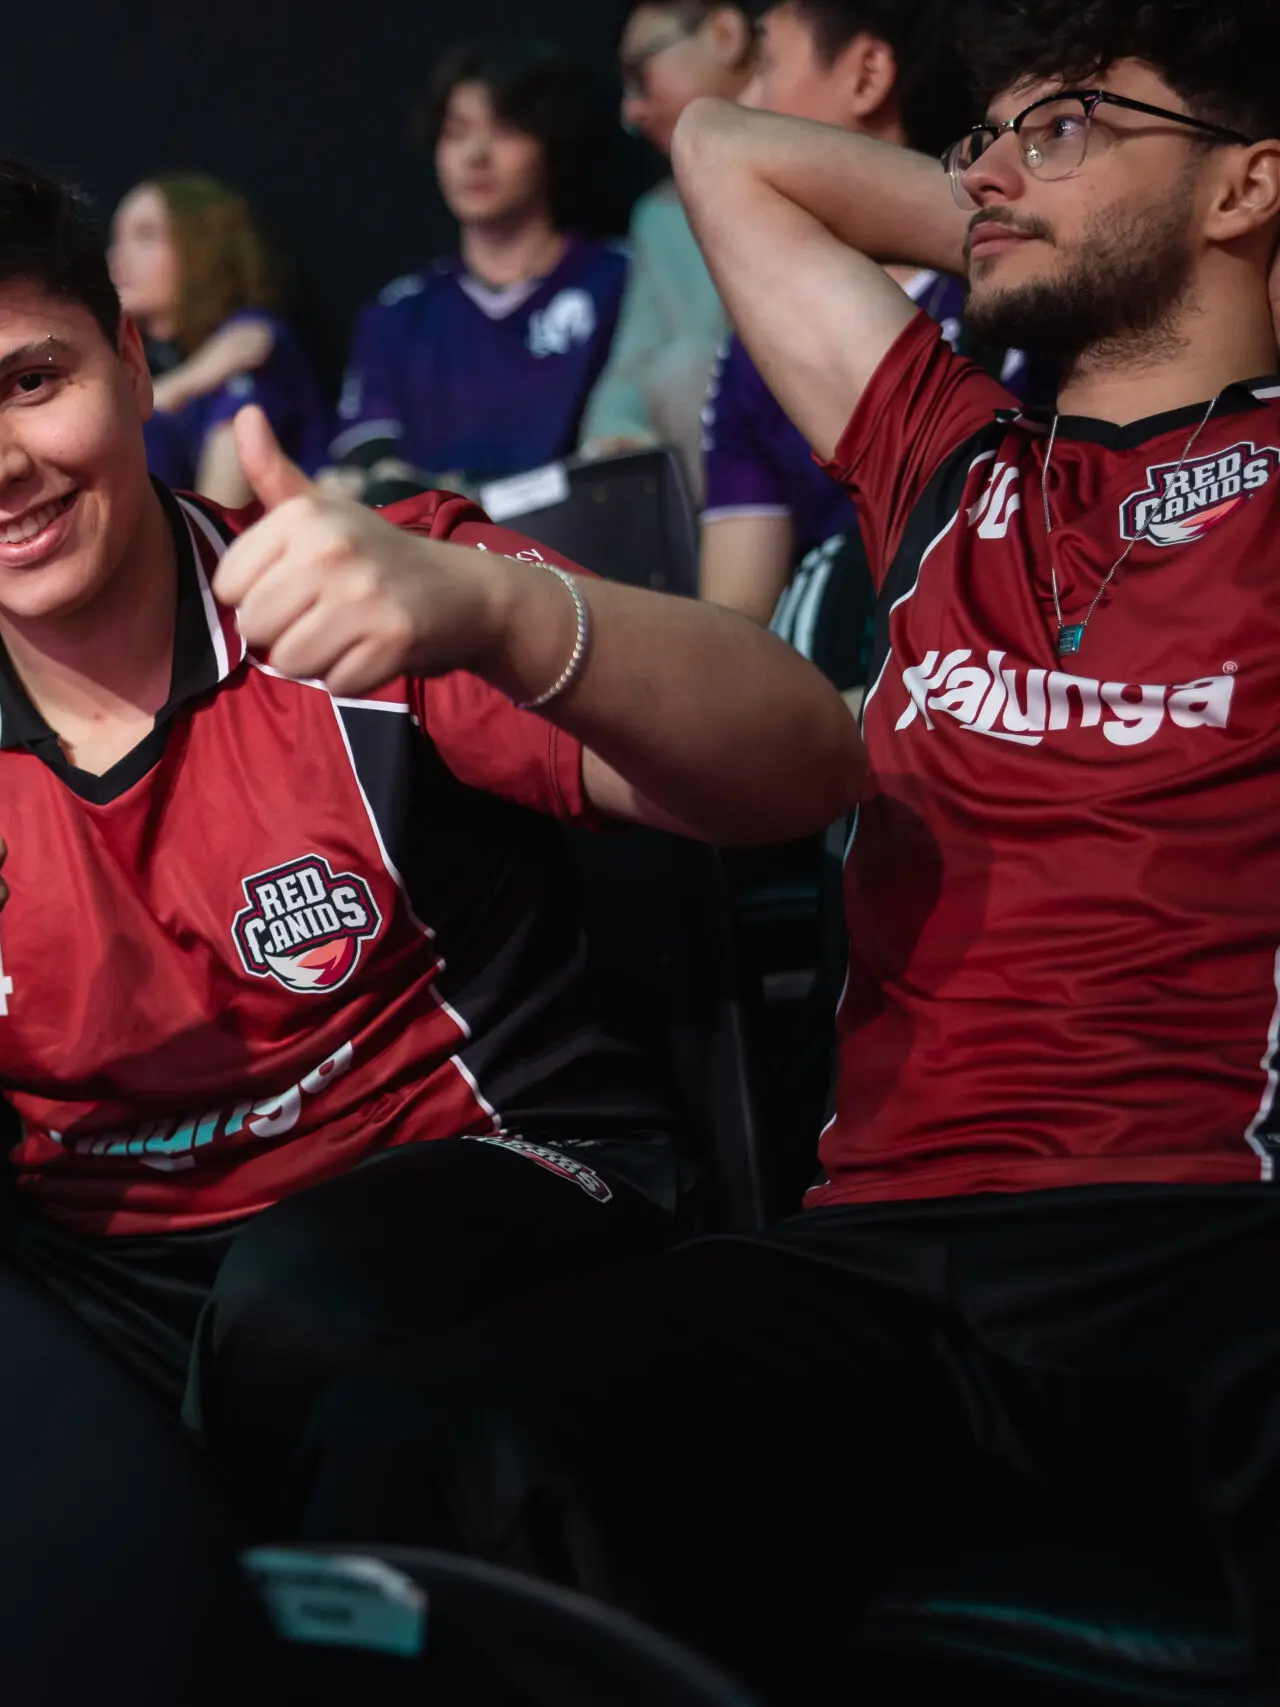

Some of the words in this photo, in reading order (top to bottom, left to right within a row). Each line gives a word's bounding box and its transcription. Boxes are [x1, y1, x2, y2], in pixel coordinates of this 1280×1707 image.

[1135, 458, 1269, 531] CANIDS
[1163, 452, 1241, 499] RED
[244, 885, 368, 964] CANIDS
[255, 866, 327, 921] RED
